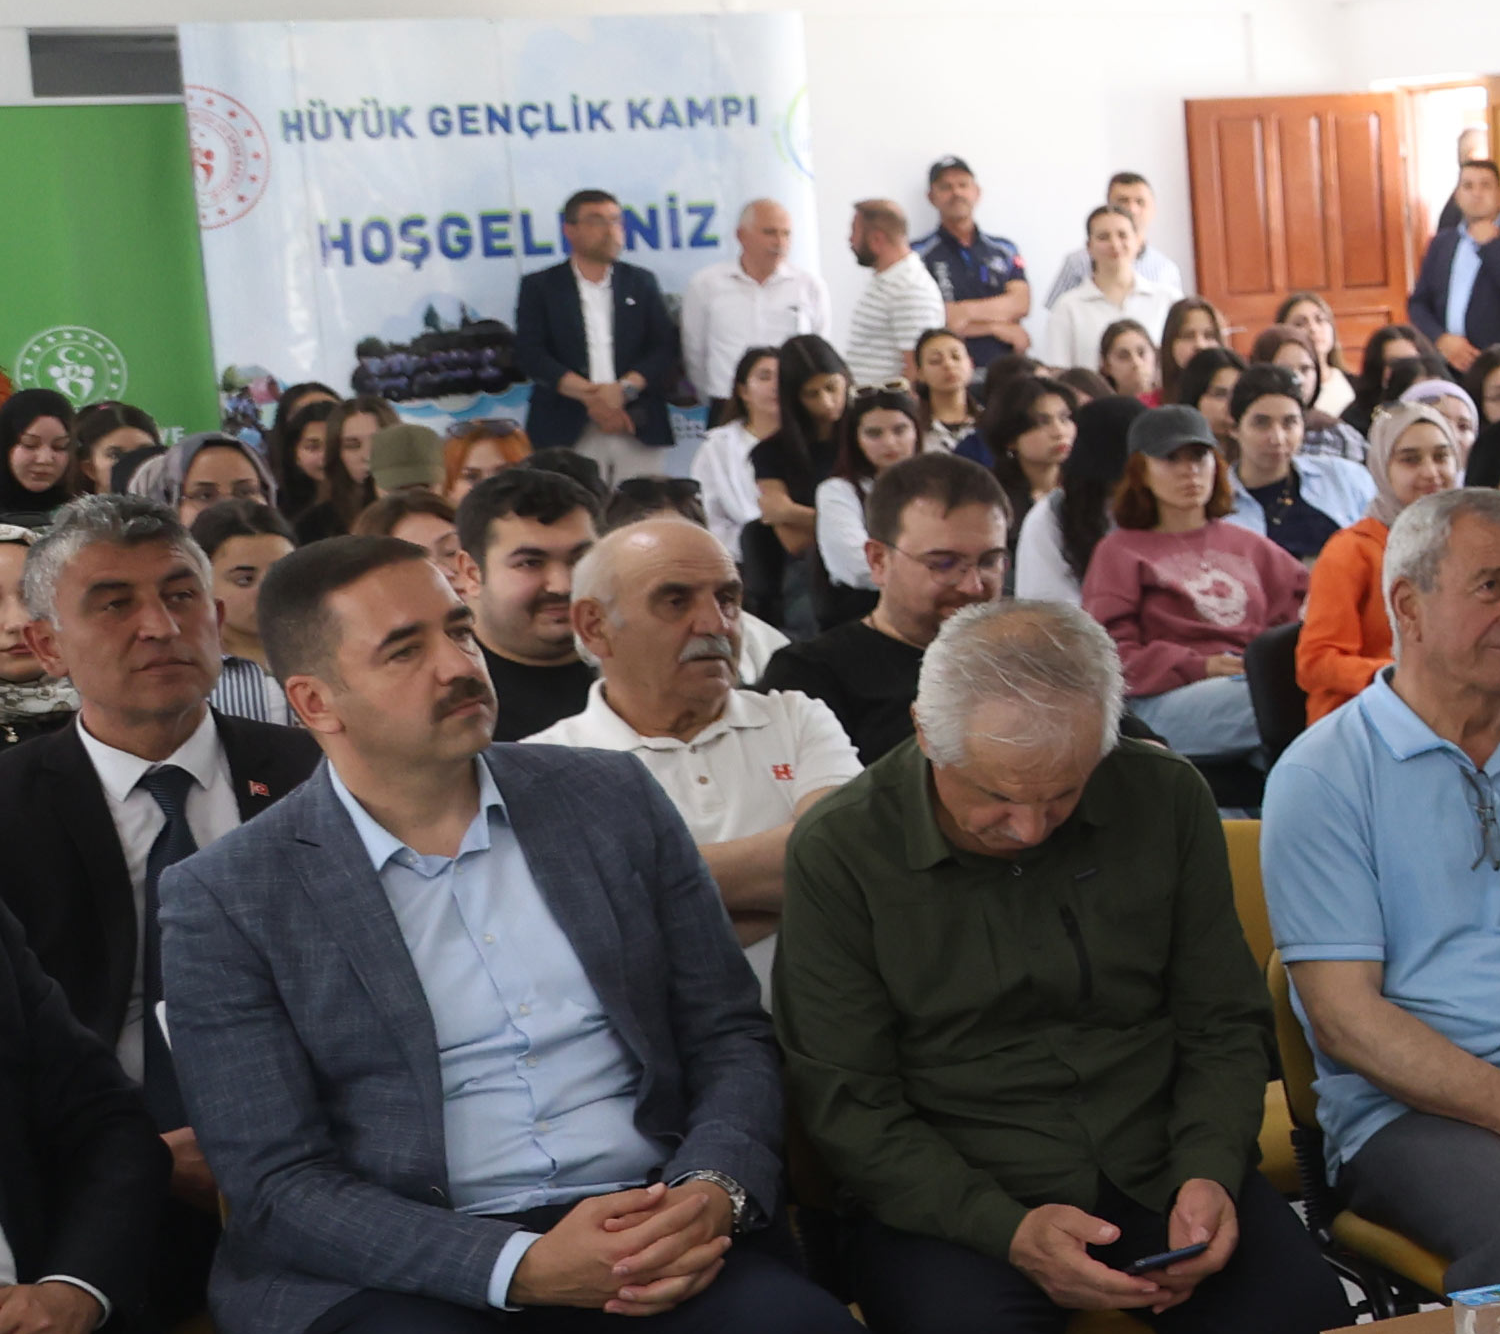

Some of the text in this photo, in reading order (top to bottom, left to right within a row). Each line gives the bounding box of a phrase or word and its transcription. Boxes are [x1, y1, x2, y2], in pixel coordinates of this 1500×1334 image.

[279, 93, 758, 143] HÜYÜK GENÇLİK KAMPI
[318, 192, 719, 270] HOŞGELNİZ
